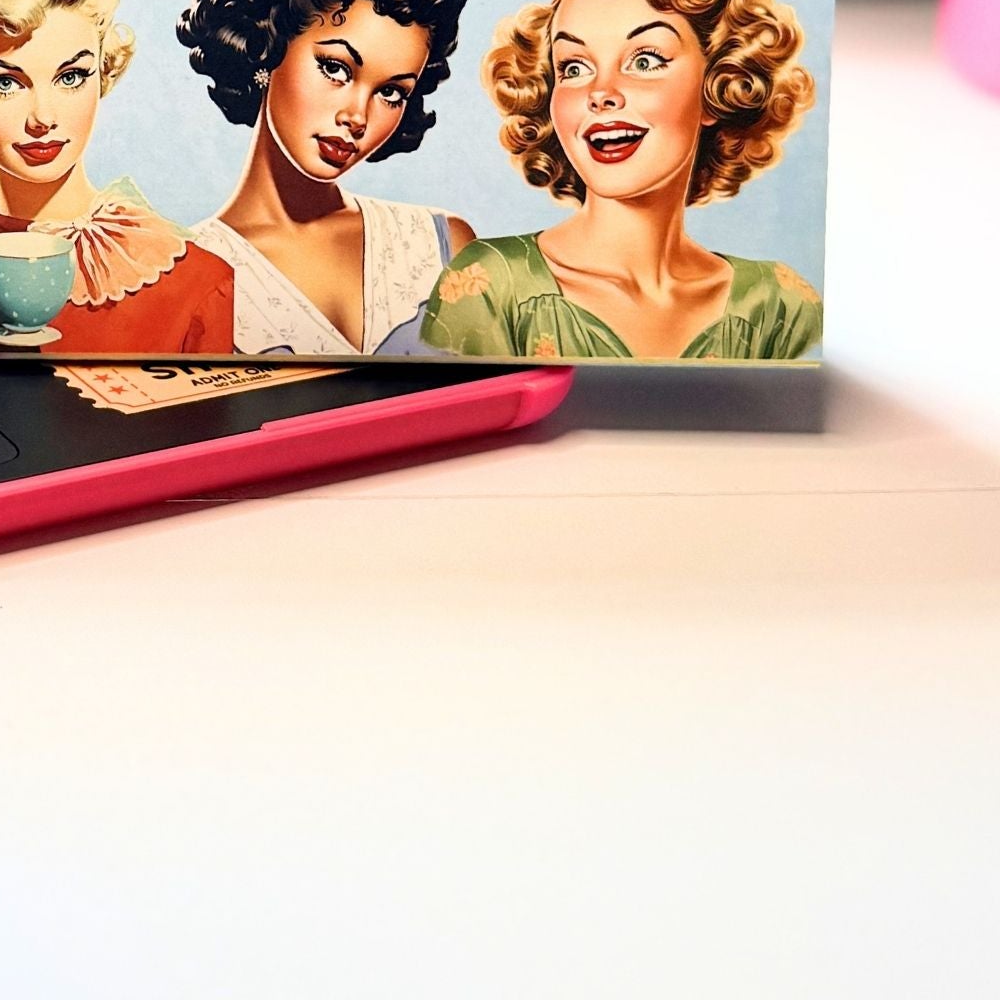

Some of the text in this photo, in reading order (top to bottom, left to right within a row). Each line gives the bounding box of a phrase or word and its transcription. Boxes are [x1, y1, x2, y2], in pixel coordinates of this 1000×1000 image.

[191, 371, 243, 387] ADMIT
[213, 373, 273, 389] NO REFUNDS
